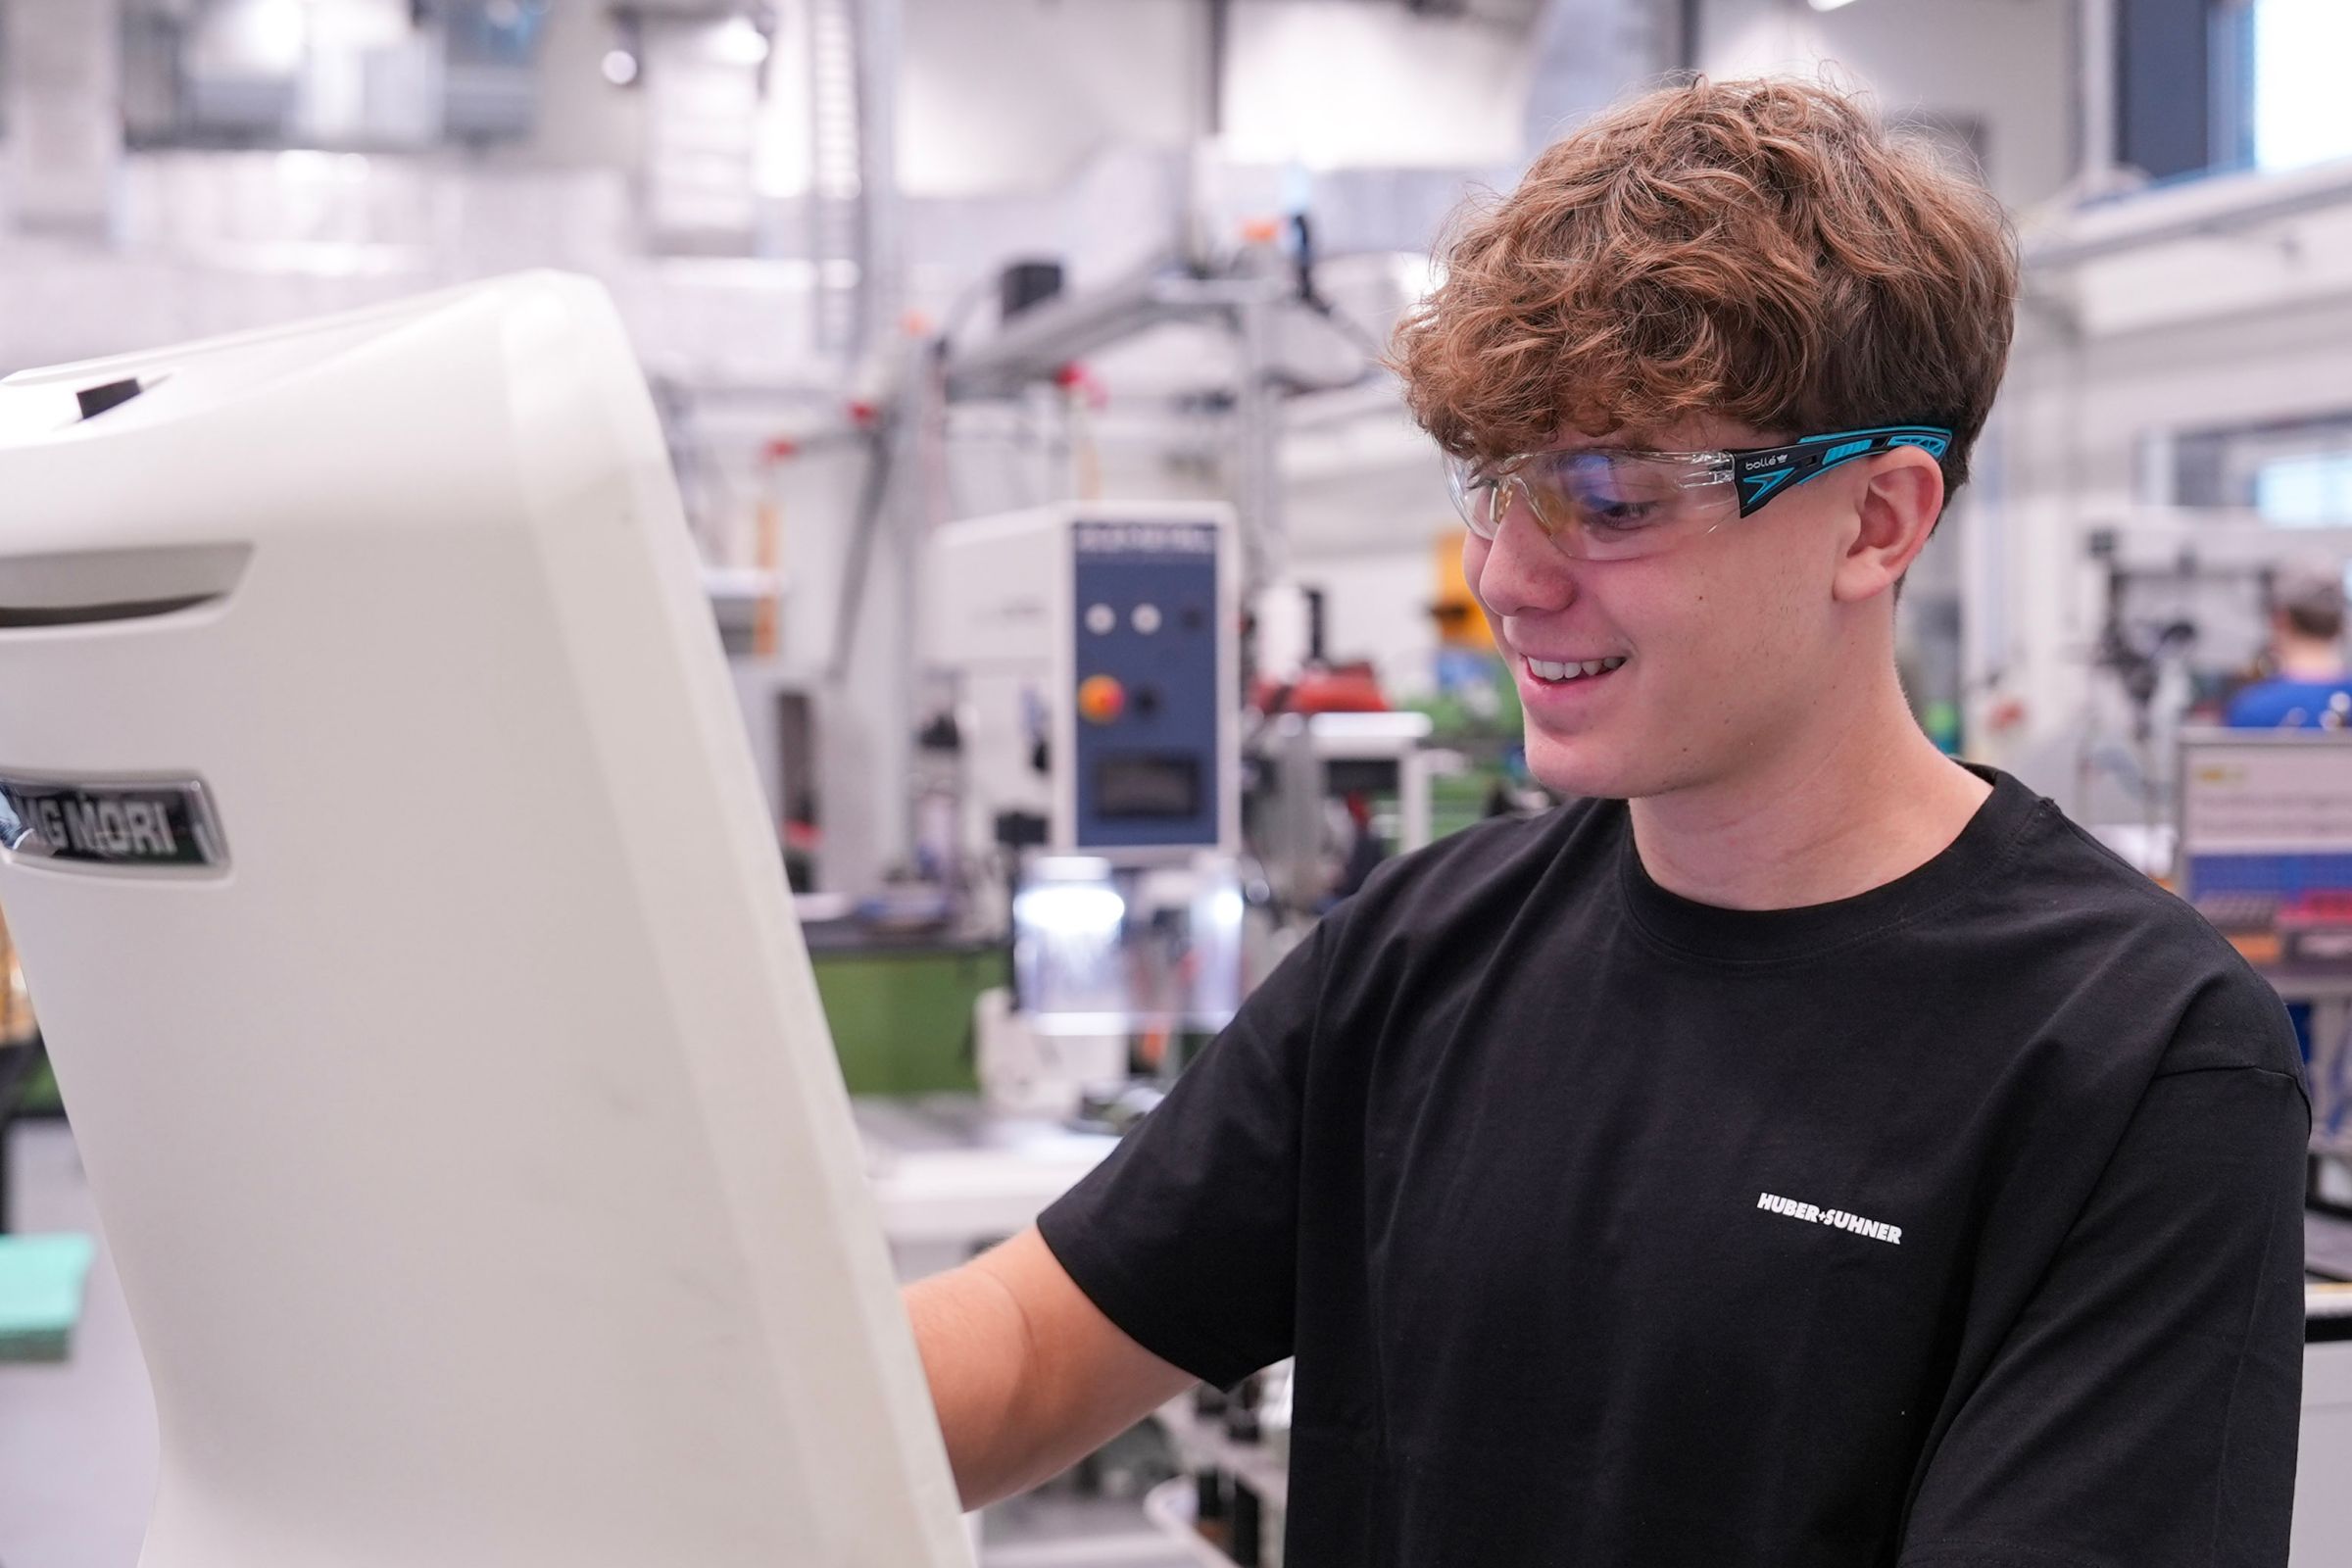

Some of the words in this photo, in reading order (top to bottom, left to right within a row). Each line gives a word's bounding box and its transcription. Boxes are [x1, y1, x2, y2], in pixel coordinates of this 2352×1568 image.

[1745, 455, 1776, 470] bollé
[63, 800, 177, 856] MORI
[1757, 1193, 1902, 1245] HUBER+SUHNER
